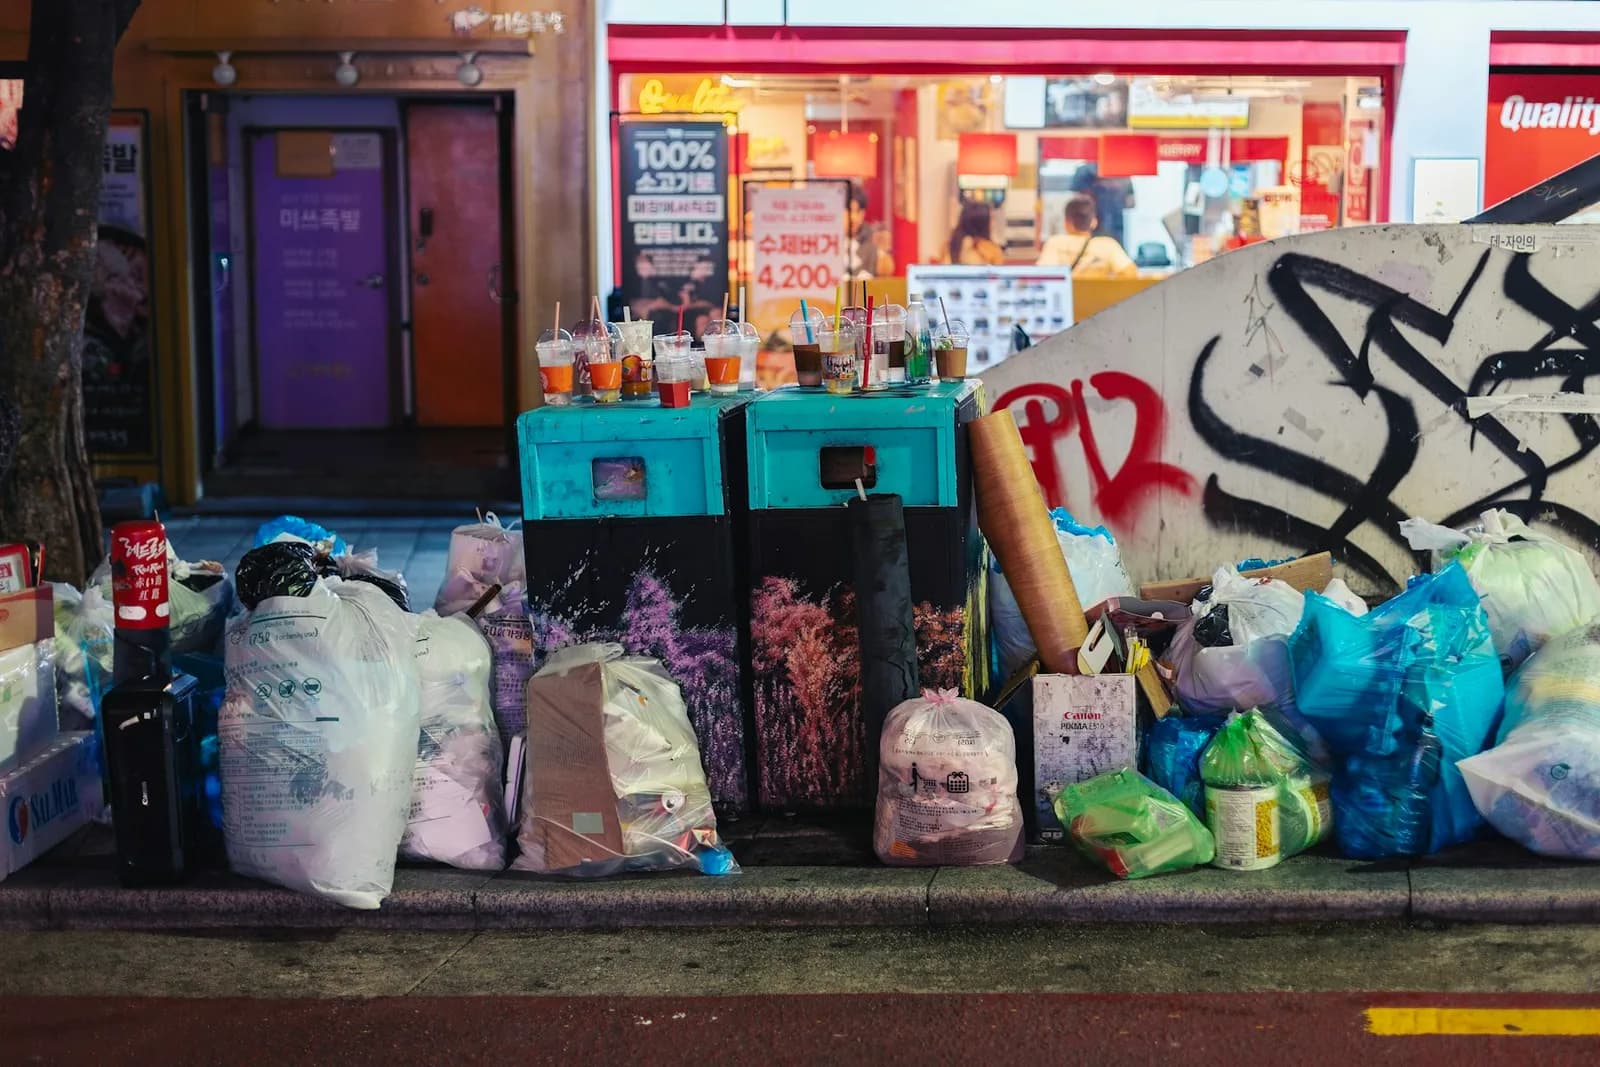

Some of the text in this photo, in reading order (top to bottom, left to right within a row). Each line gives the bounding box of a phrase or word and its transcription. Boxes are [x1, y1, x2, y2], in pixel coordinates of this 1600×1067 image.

[1500, 94, 1600, 136] Quality
[634, 140, 716, 170] 100%
[635, 172, 716, 193] 소고기를
[633, 222, 719, 245] 만듭니다.
[758, 233, 839, 256] 수제버거
[1060, 722, 1088, 730] PIXMA
[1063, 711, 1101, 720] Canon
